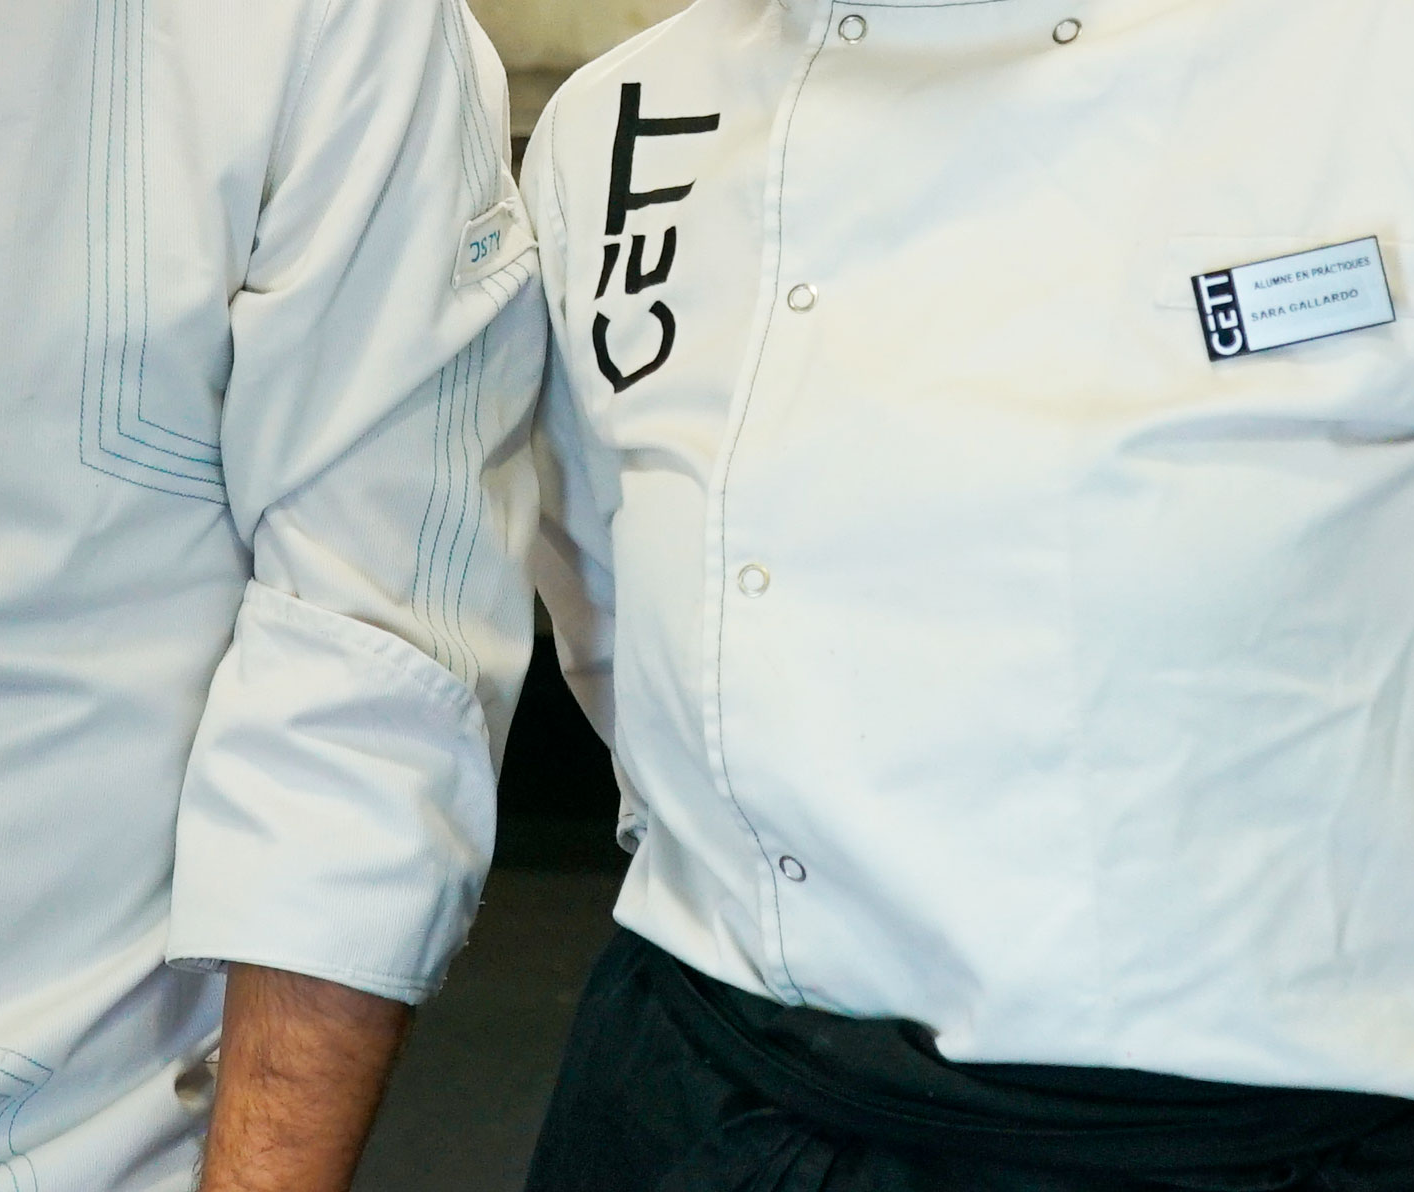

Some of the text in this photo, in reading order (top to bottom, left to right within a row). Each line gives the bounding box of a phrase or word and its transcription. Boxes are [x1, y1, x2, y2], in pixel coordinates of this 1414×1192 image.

[592, 82, 721, 394] CETT
[1250, 288, 1359, 323] SARA GALLARDO
[1253, 273, 1294, 291] ALUMNE
[1295, 270, 1310, 282] EN
[1198, 274, 1243, 356] CETT
